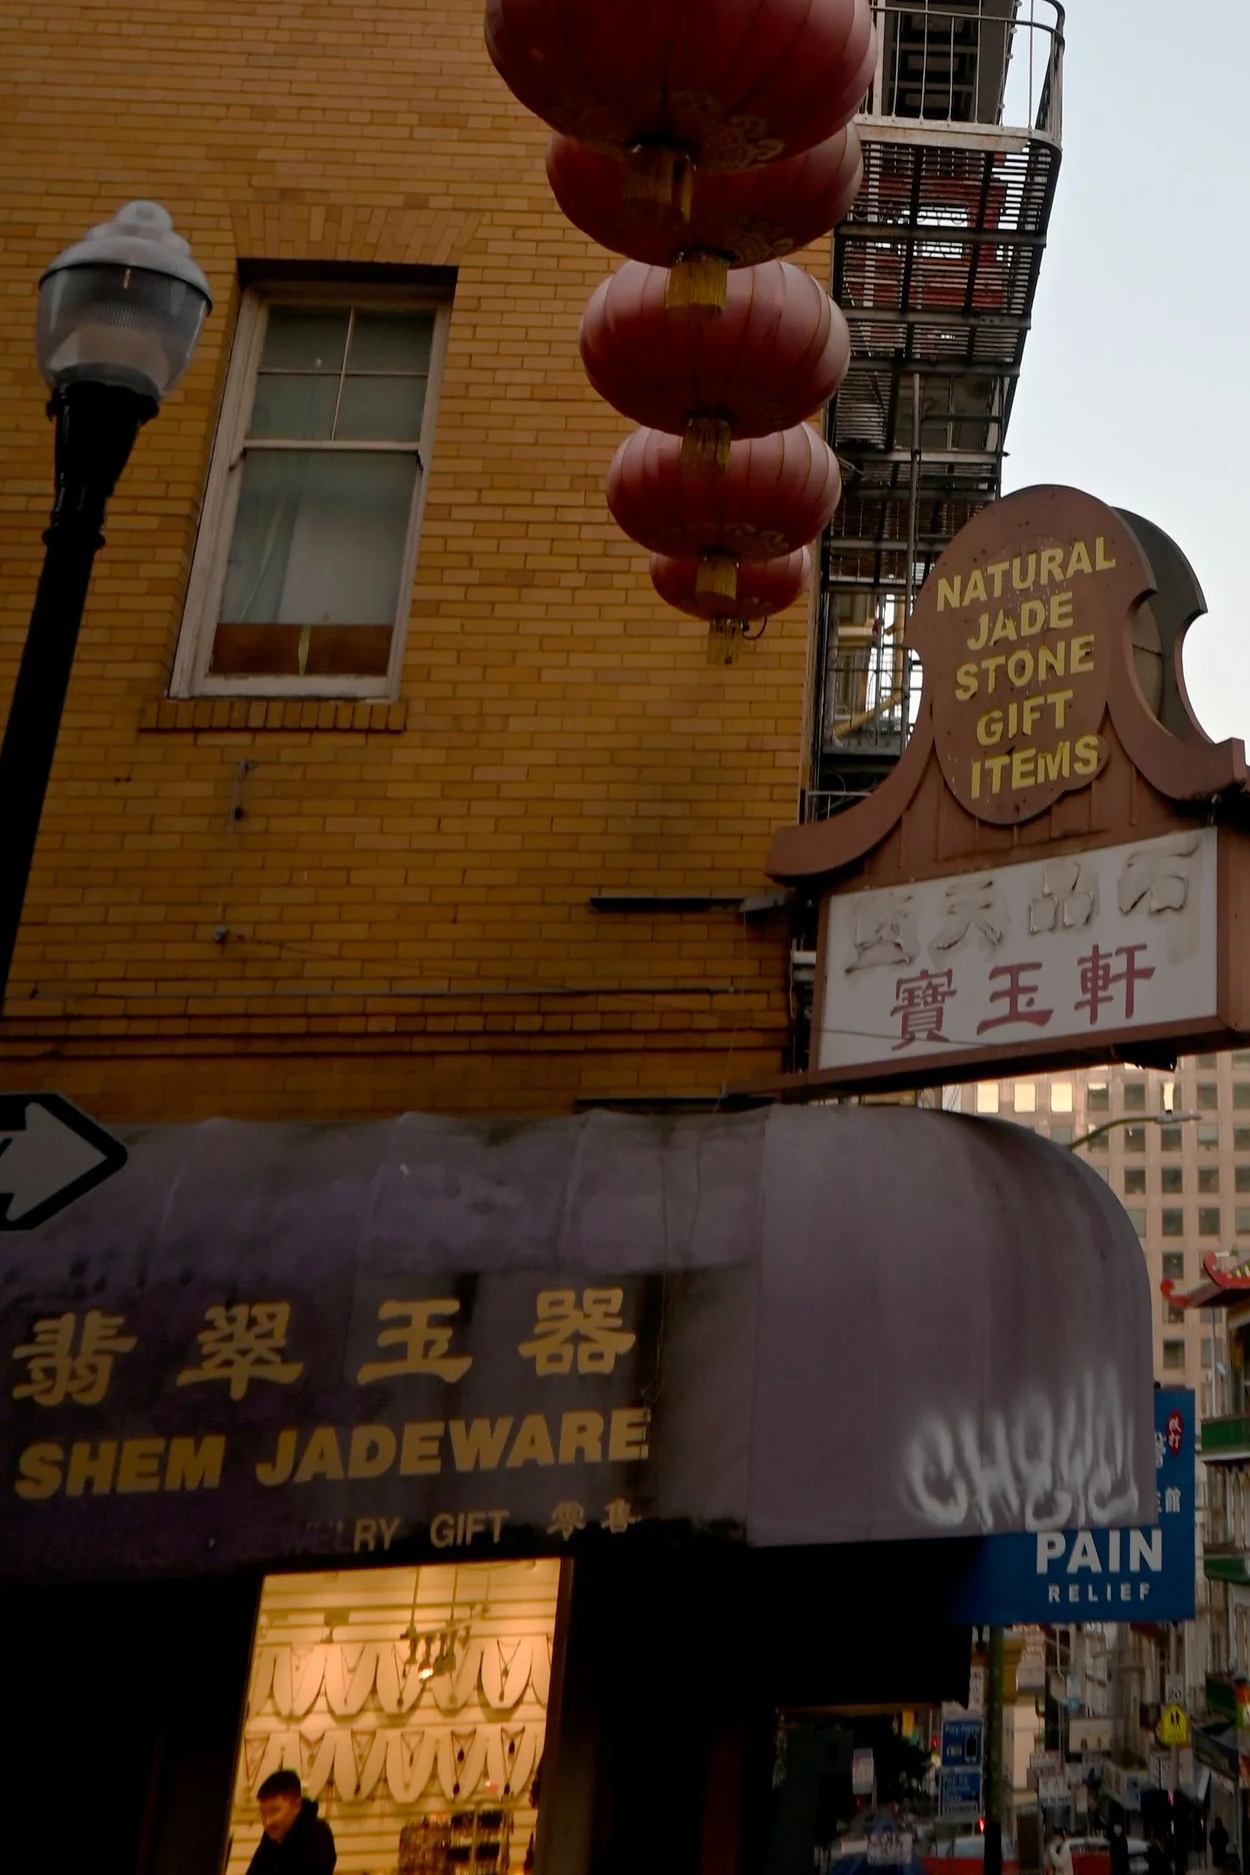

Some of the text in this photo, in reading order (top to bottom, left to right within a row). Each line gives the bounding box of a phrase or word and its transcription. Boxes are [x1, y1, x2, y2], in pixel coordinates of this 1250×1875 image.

[936, 536, 1116, 612] NATURAL
[966, 591, 1074, 651] JADE
[954, 634, 1095, 701] STONE
[976, 689, 1074, 747] GIFT
[971, 734, 1100, 799] ITEMS
[890, 943, 1156, 1051] 寶玉軒
[12, 1287, 637, 1408] 翡翠玉器
[12, 1406, 650, 1501] SHEM JADEWARE
[429, 1509, 510, 1550] GIFT
[1036, 1528, 1163, 1574] PAIN
[1048, 1582, 1150, 1604] RELIEF
